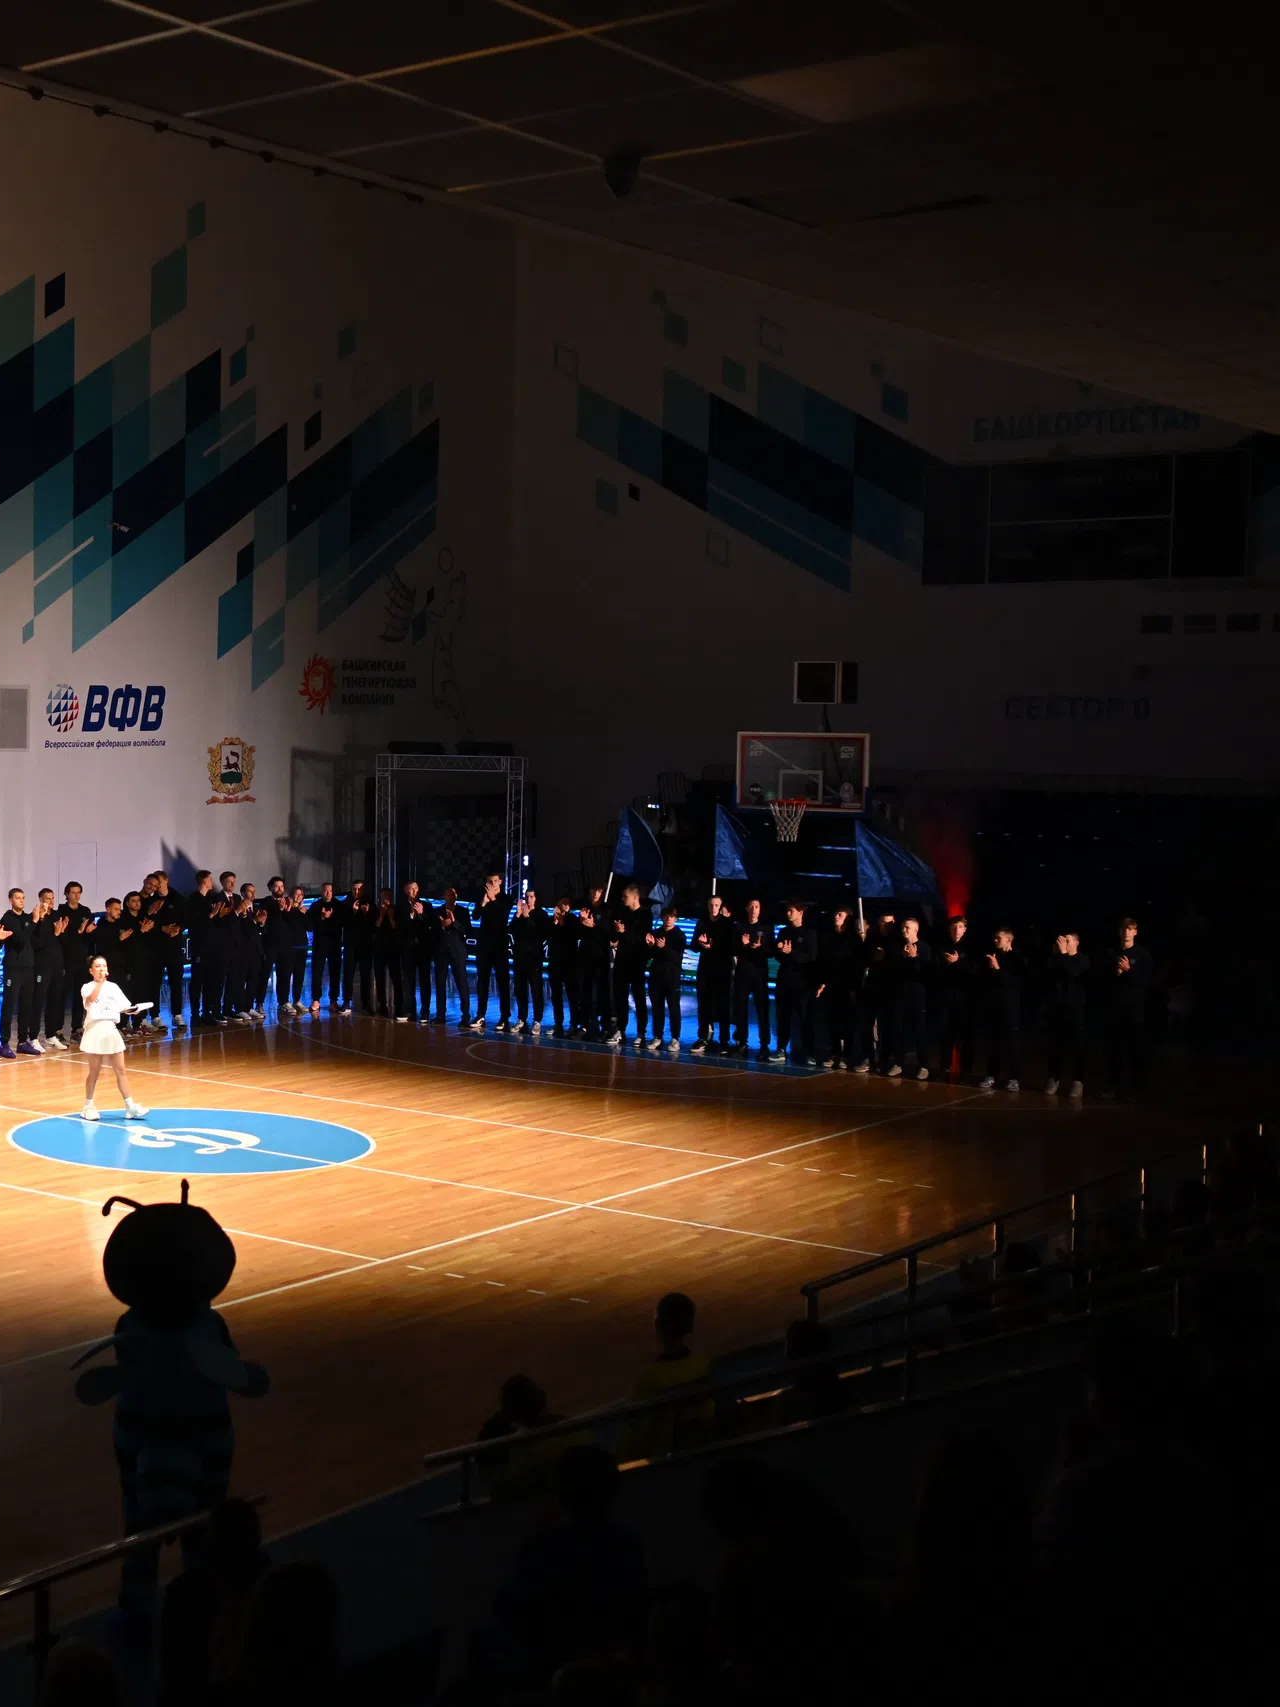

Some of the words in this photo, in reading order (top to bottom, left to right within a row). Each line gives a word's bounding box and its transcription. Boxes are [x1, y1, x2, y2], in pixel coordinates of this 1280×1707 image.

[972, 404, 1201, 443] БАШКОРТОСТАН
[341, 659, 407, 672] БАШКИРСКАЯ
[341, 694, 395, 705] КОМПАНИЯ
[81, 684, 166, 732] ВФВ
[44, 740, 94, 749] Всероссийская
[95, 740, 132, 748] федерация
[132, 739, 166, 747] волейбола
